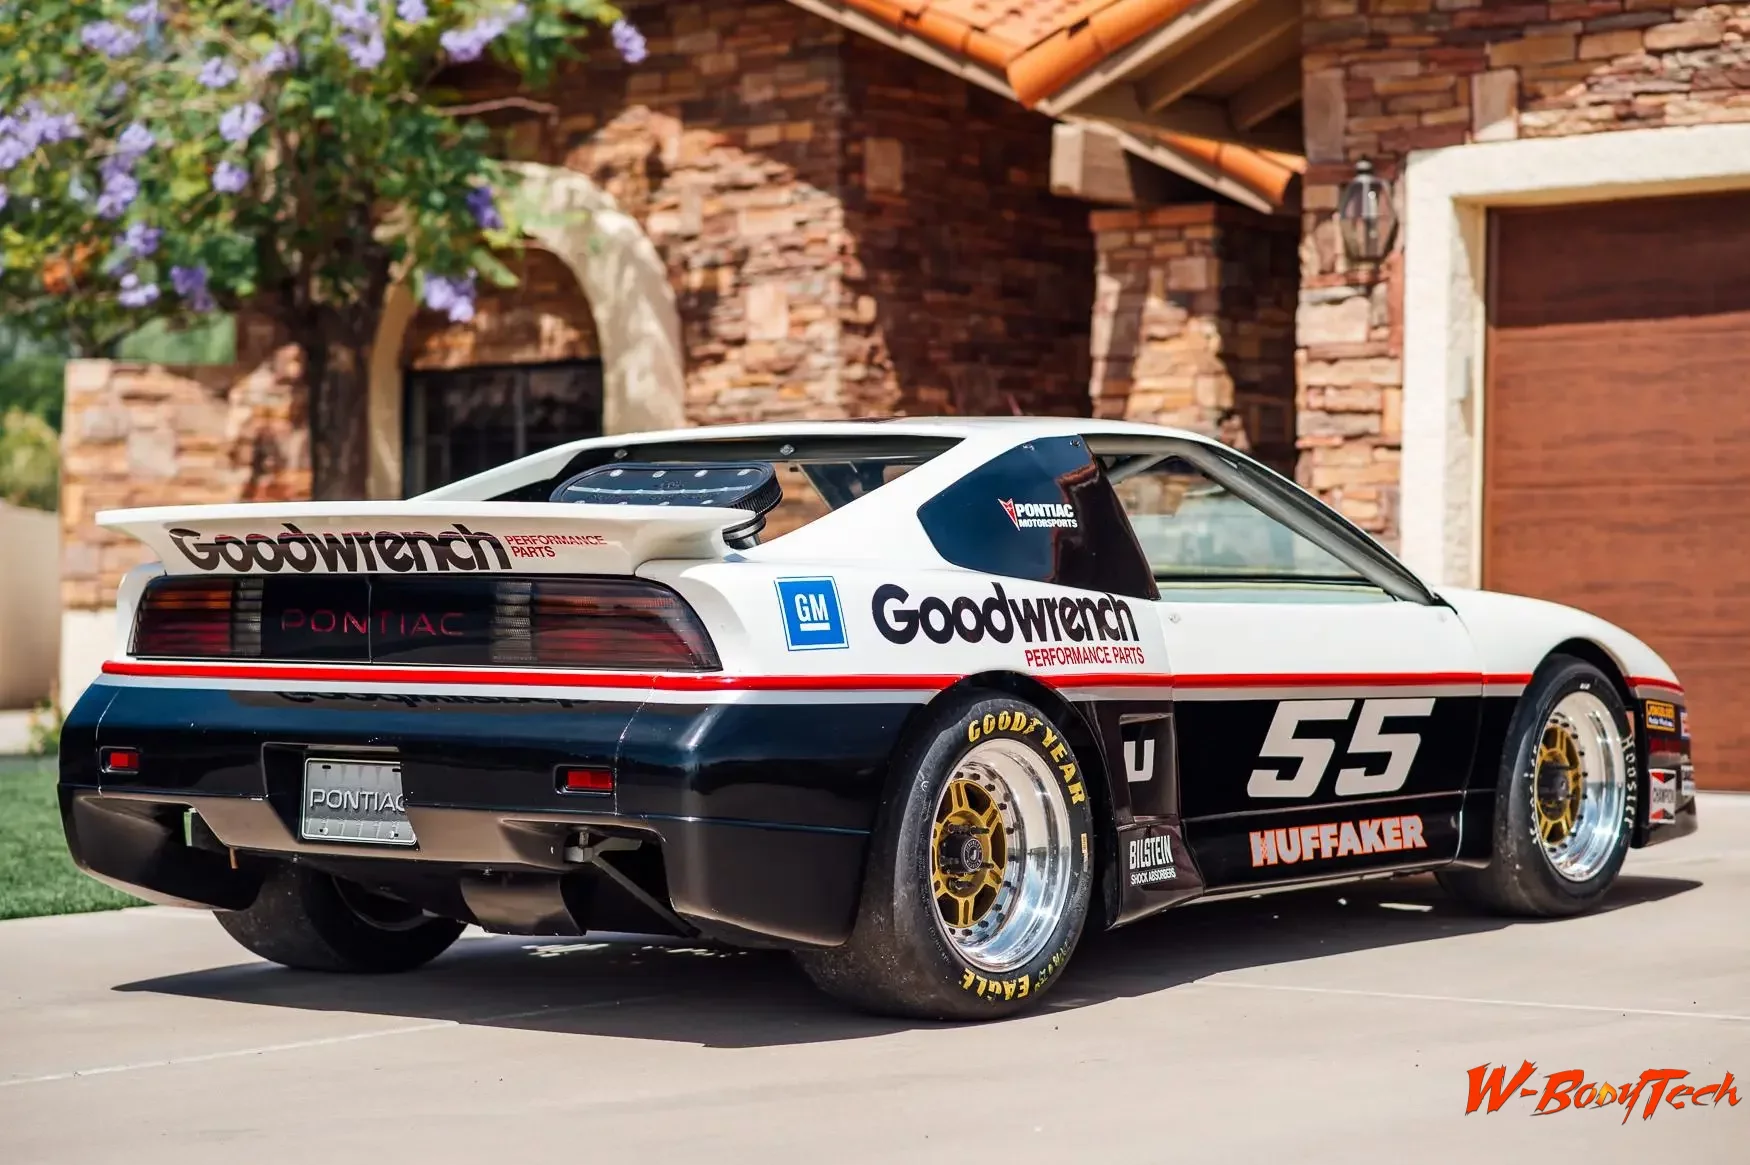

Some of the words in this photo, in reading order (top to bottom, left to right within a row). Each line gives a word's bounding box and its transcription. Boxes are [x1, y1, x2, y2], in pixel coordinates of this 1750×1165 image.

[1015, 503, 1074, 518] PONTIAC
[1018, 518, 1078, 528] MOTORSPORTS
[168, 523, 512, 573] Goodwrench
[504, 535, 606, 547] PERFORMANCE
[512, 546, 556, 558] PARTS
[281, 608, 465, 636] PONTIAC
[794, 594, 830, 623] GM
[872, 582, 1140, 645] Goodwrench
[1025, 649, 1112, 668] PERFORMANCE
[1113, 647, 1145, 665] PARTS
[1247, 698, 1436, 798] 55
[1129, 834, 1174, 870] BILSTEIN
[1249, 815, 1428, 868] HUFFAKER
[1130, 872, 1149, 885] SHOCK
[1148, 867, 1177, 882] ABSORBERS
[960, 966, 1030, 1001] EAGLE
